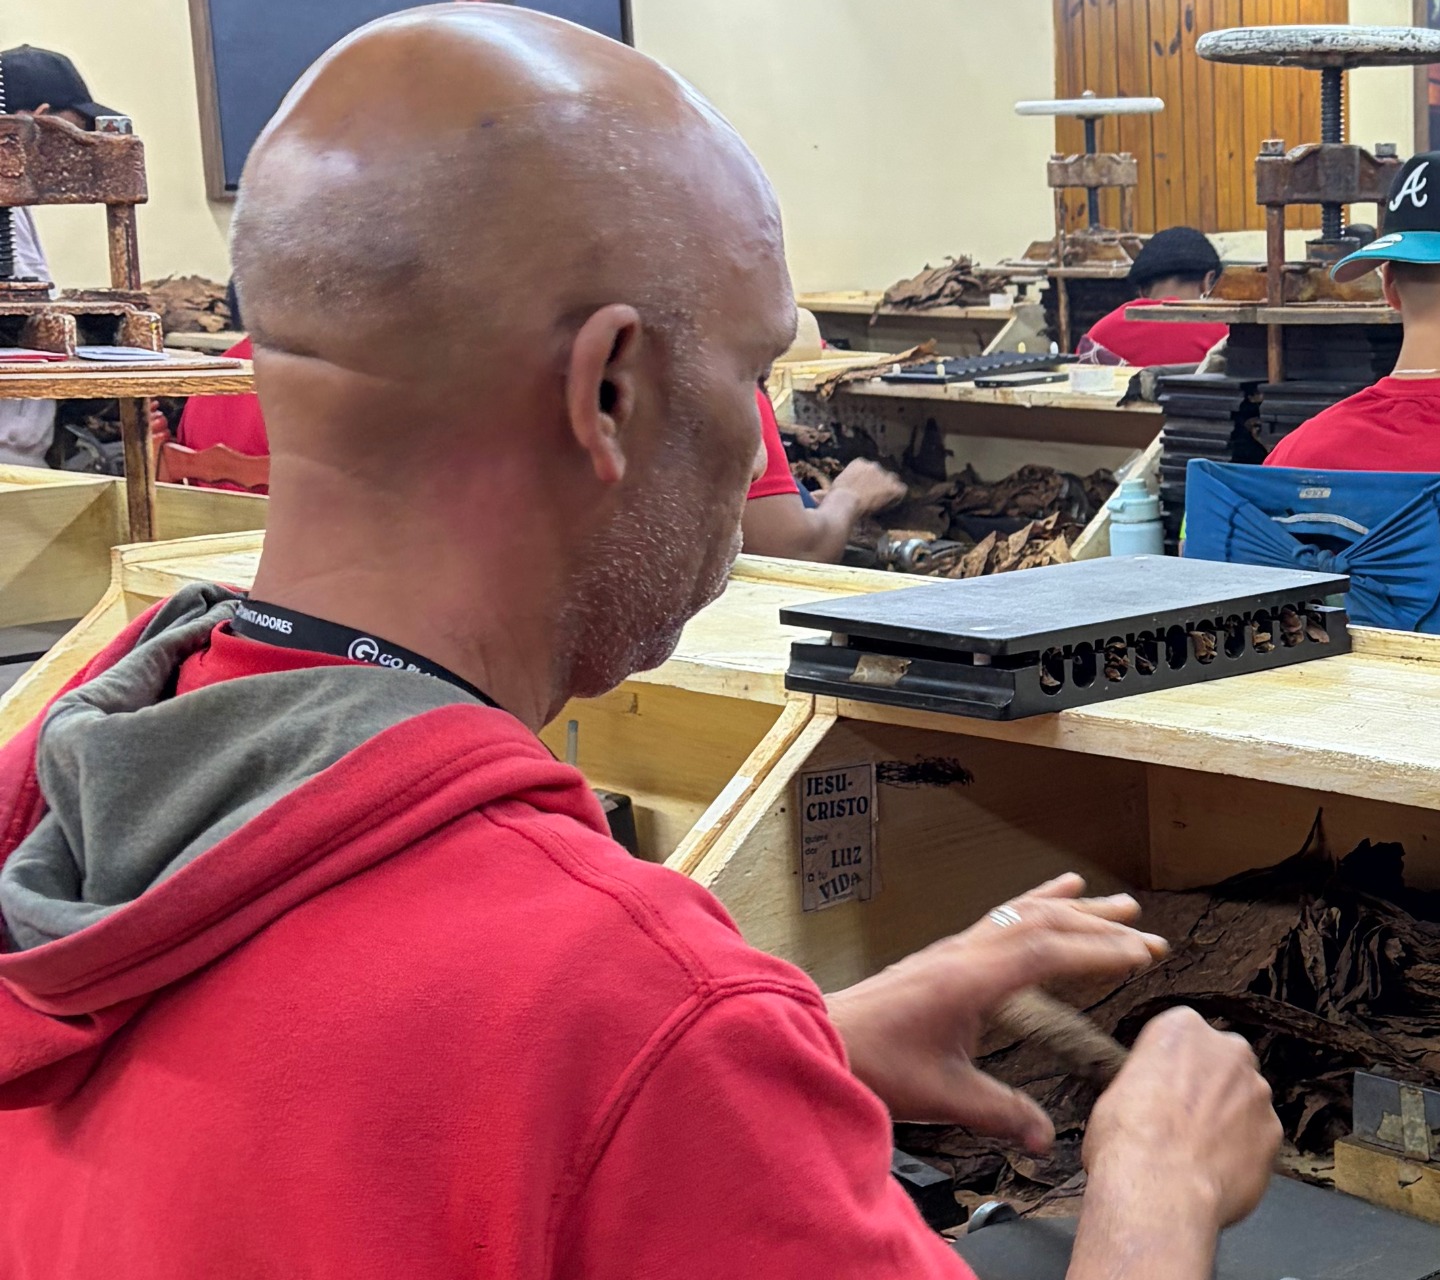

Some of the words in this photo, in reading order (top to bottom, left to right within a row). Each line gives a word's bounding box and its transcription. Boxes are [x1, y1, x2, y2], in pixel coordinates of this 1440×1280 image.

[1388, 161, 1429, 211] A
[806, 773, 853, 797] JESU-
[806, 796, 868, 821] CRISTO
[831, 846, 862, 868] LUZ
[819, 872, 862, 899] VIDA
